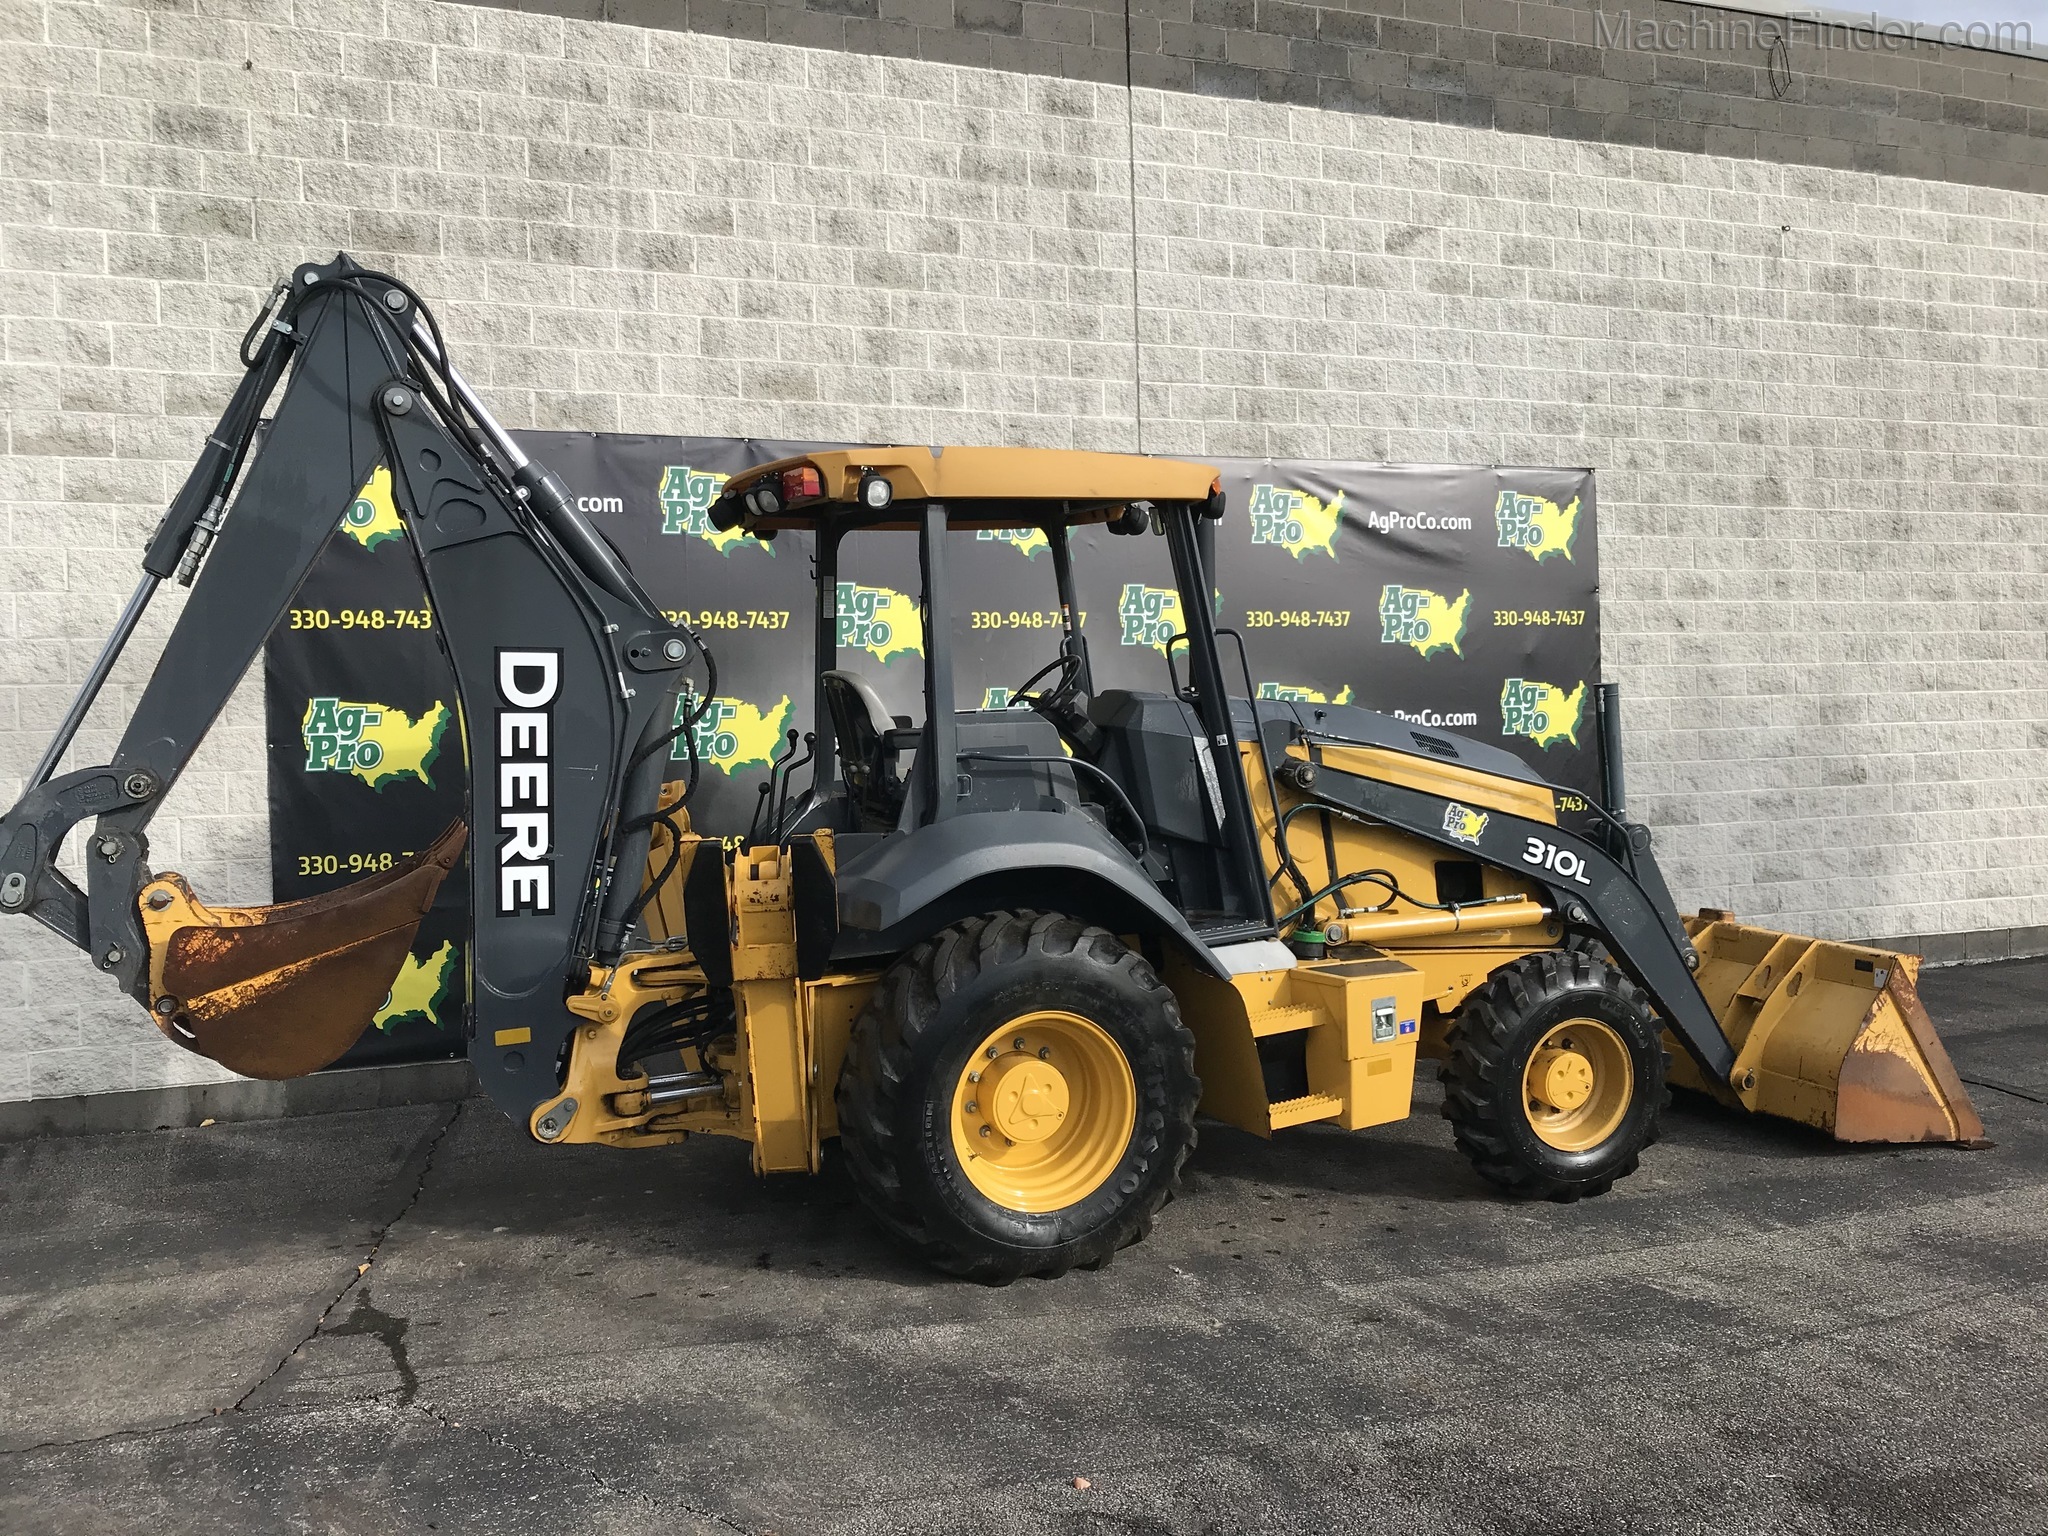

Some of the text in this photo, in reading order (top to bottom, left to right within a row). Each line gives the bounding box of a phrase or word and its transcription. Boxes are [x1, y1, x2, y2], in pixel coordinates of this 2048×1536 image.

[1251, 484, 1303, 521] Ag-
[1497, 490, 1543, 526] Ag-
[1251, 513, 1304, 544] Pro
[1368, 510, 1472, 534] AgProCo.com
[1497, 518, 1544, 547] Pro
[836, 582, 891, 623] Ag-
[1121, 584, 1175, 621] Ag-
[1246, 610, 1351, 628] 330-948-7437
[1381, 585, 1430, 620] Ag-
[1493, 610, 1585, 626] 330-948-7437
[836, 614, 892, 647] Pro
[1121, 613, 1176, 645] Pro
[1381, 613, 1431, 643] Pro
[1502, 678, 1548, 713] Ag-
[304, 698, 382, 742] Ag-
[1502, 706, 1549, 735] Pro
[305, 733, 384, 771] Pro
[500, 652, 558, 911] DEERE
[1446, 817, 1466, 831] Pro
[1448, 805, 1468, 821] Ag-
[1522, 837, 1591, 885] 310L
